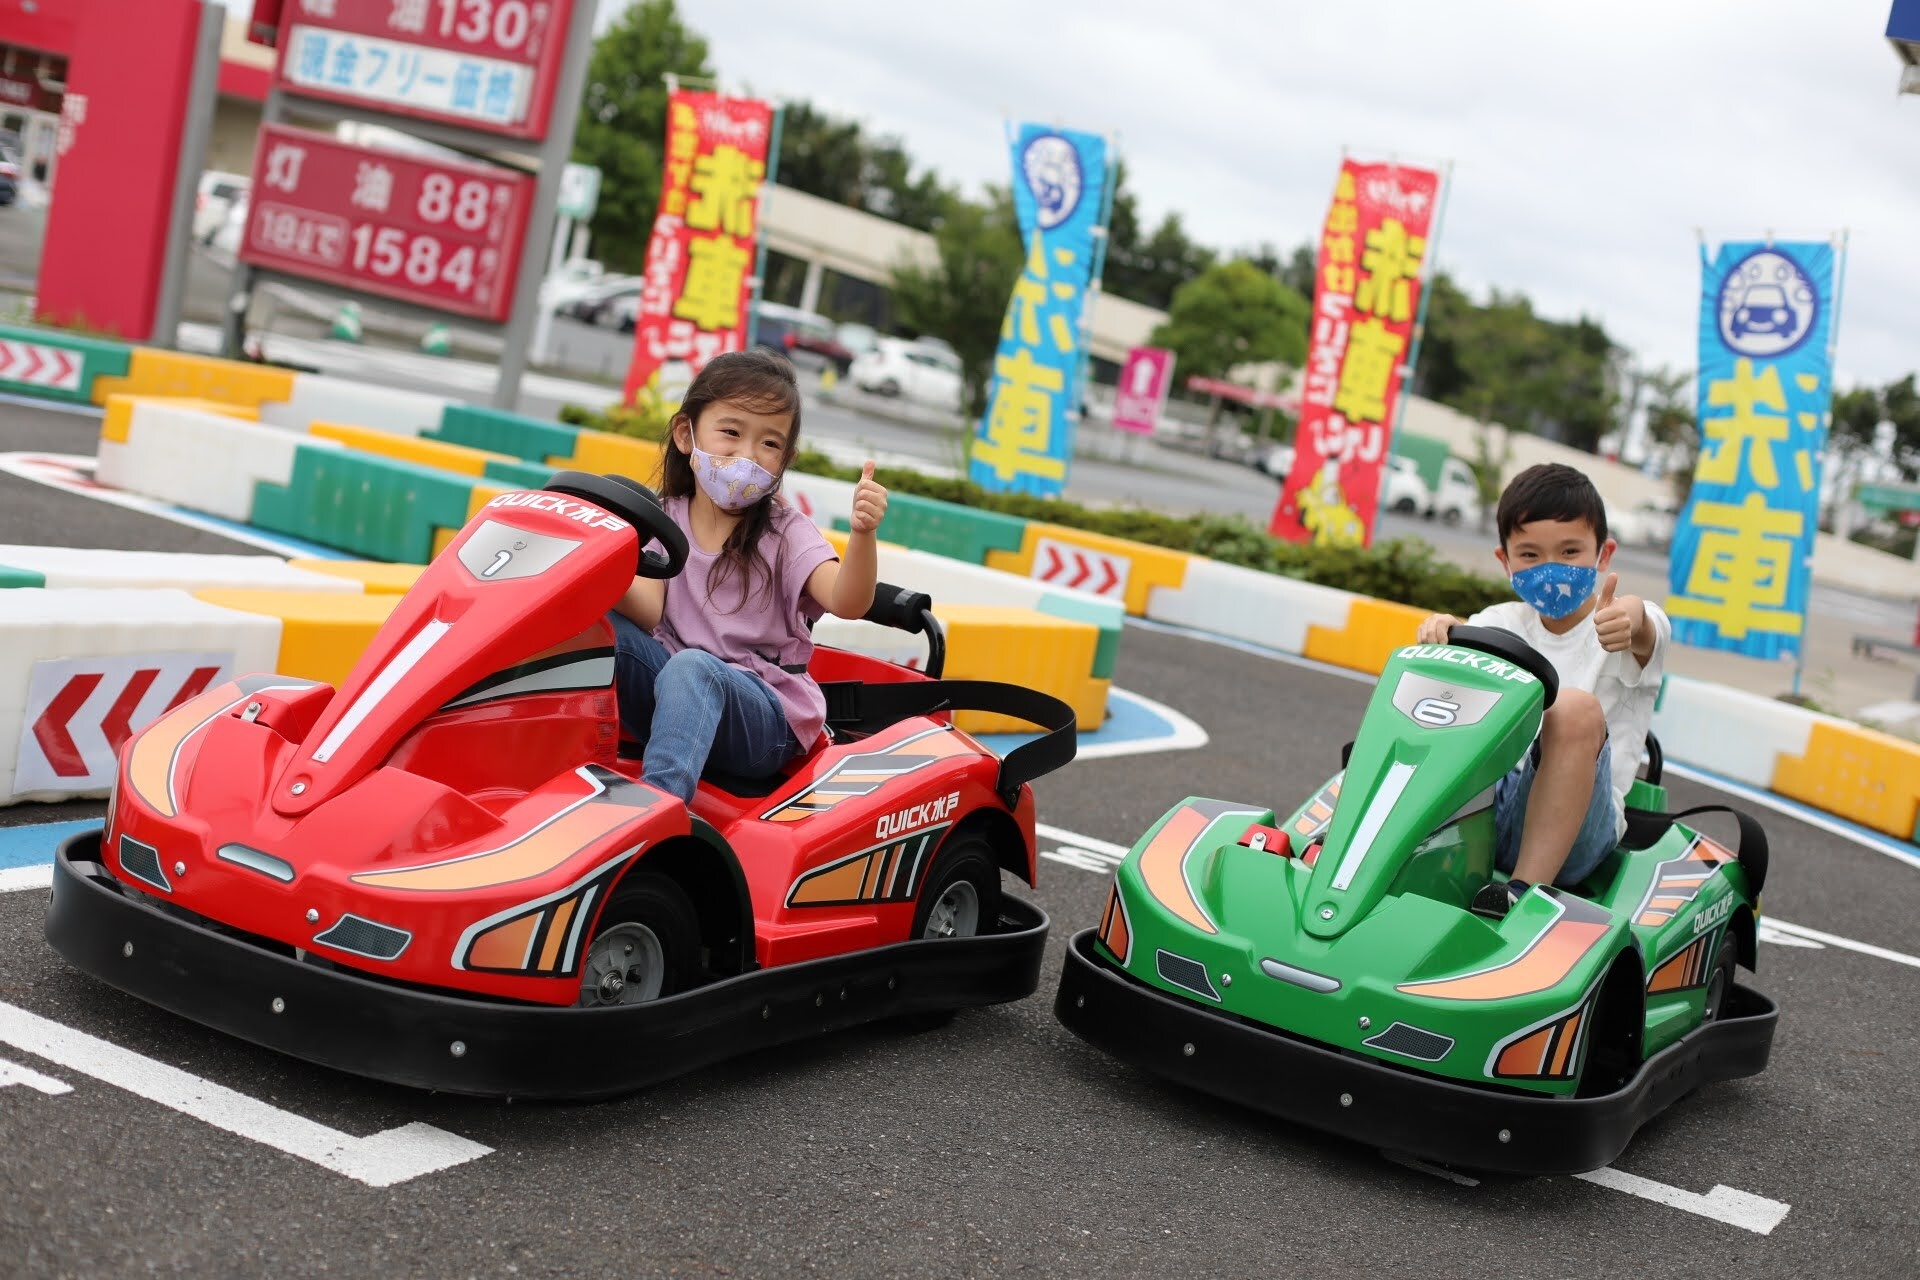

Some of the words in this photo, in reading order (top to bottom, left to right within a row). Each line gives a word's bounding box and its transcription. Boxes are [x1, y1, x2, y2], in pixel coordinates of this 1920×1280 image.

[438, 0, 528, 48] 130
[417, 172, 490, 230] 88
[352, 223, 475, 293] 1584
[481, 549, 513, 578] 1
[1411, 697, 1461, 726] 6
[875, 790, 960, 839] QUICK水戸
